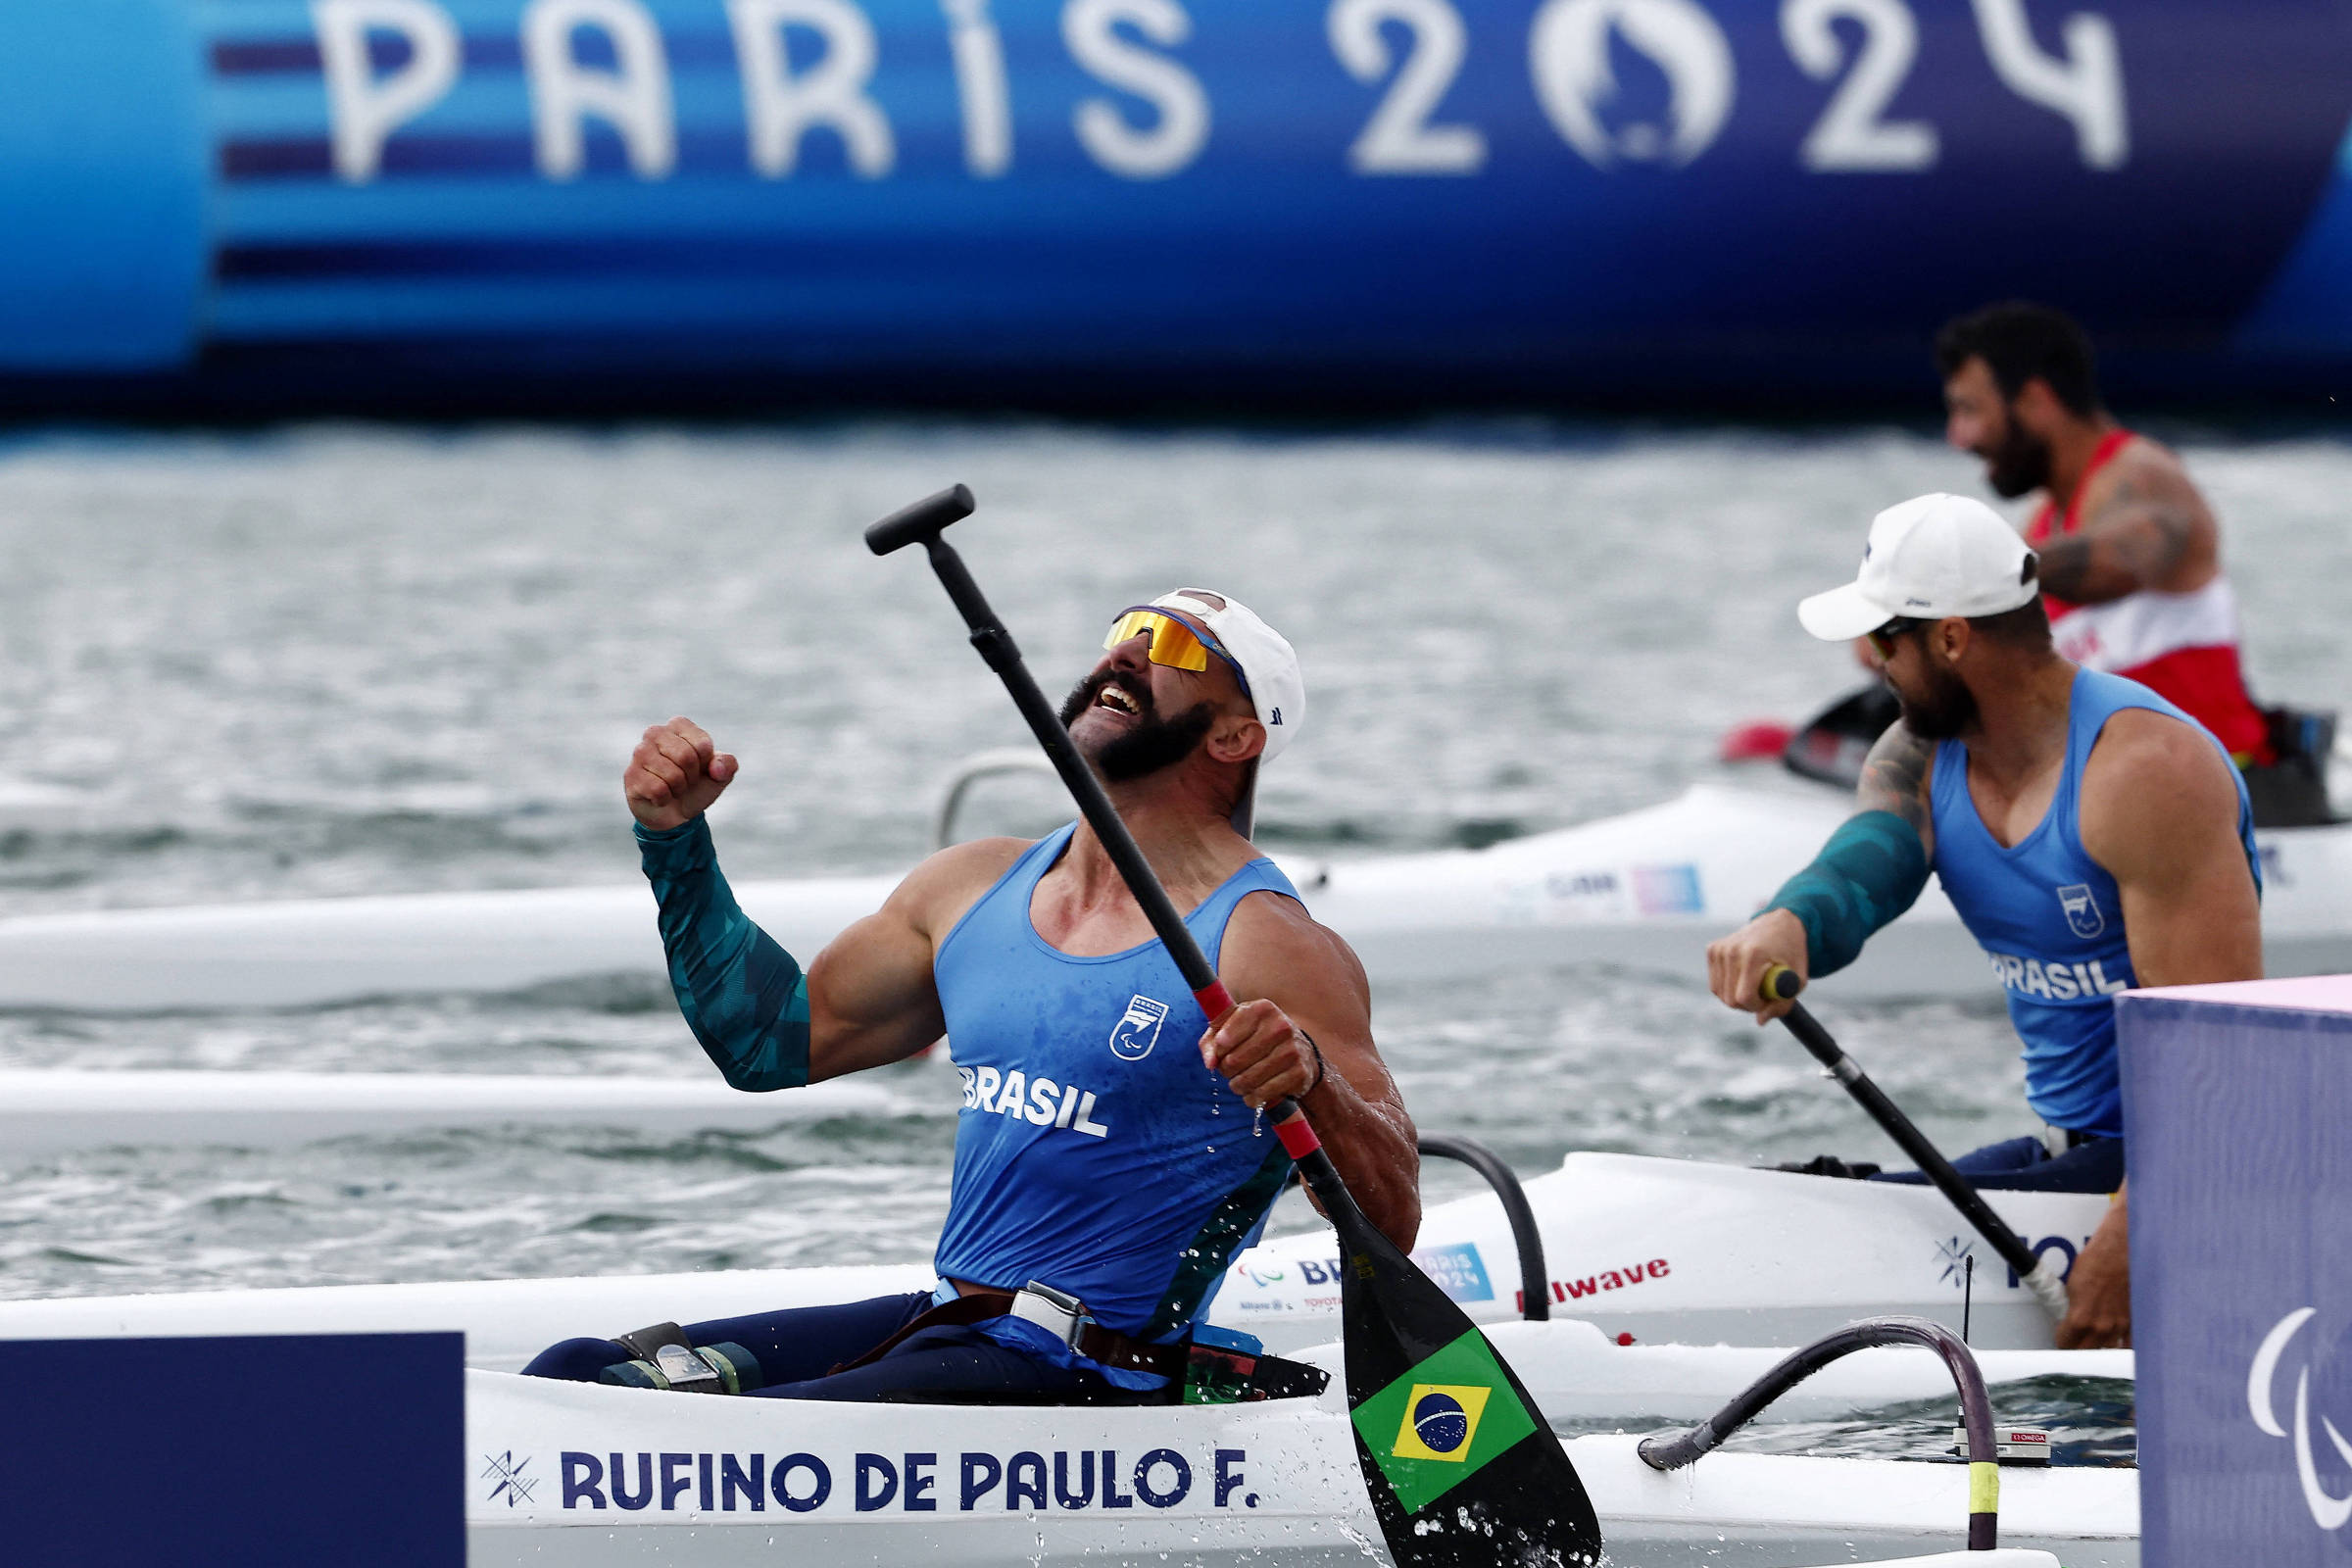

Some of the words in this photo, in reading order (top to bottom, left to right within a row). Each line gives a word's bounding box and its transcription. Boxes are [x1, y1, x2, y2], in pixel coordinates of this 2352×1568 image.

[309, 0, 1211, 183] PARIS
[1327, 0, 2129, 174] 2024
[957, 1065, 1108, 1138] BRASIL
[560, 1451, 832, 1513] RUFINO
[855, 1452, 937, 1512] DE
[959, 1448, 1192, 1510] PAULO
[1214, 1448, 1261, 1508] F.
